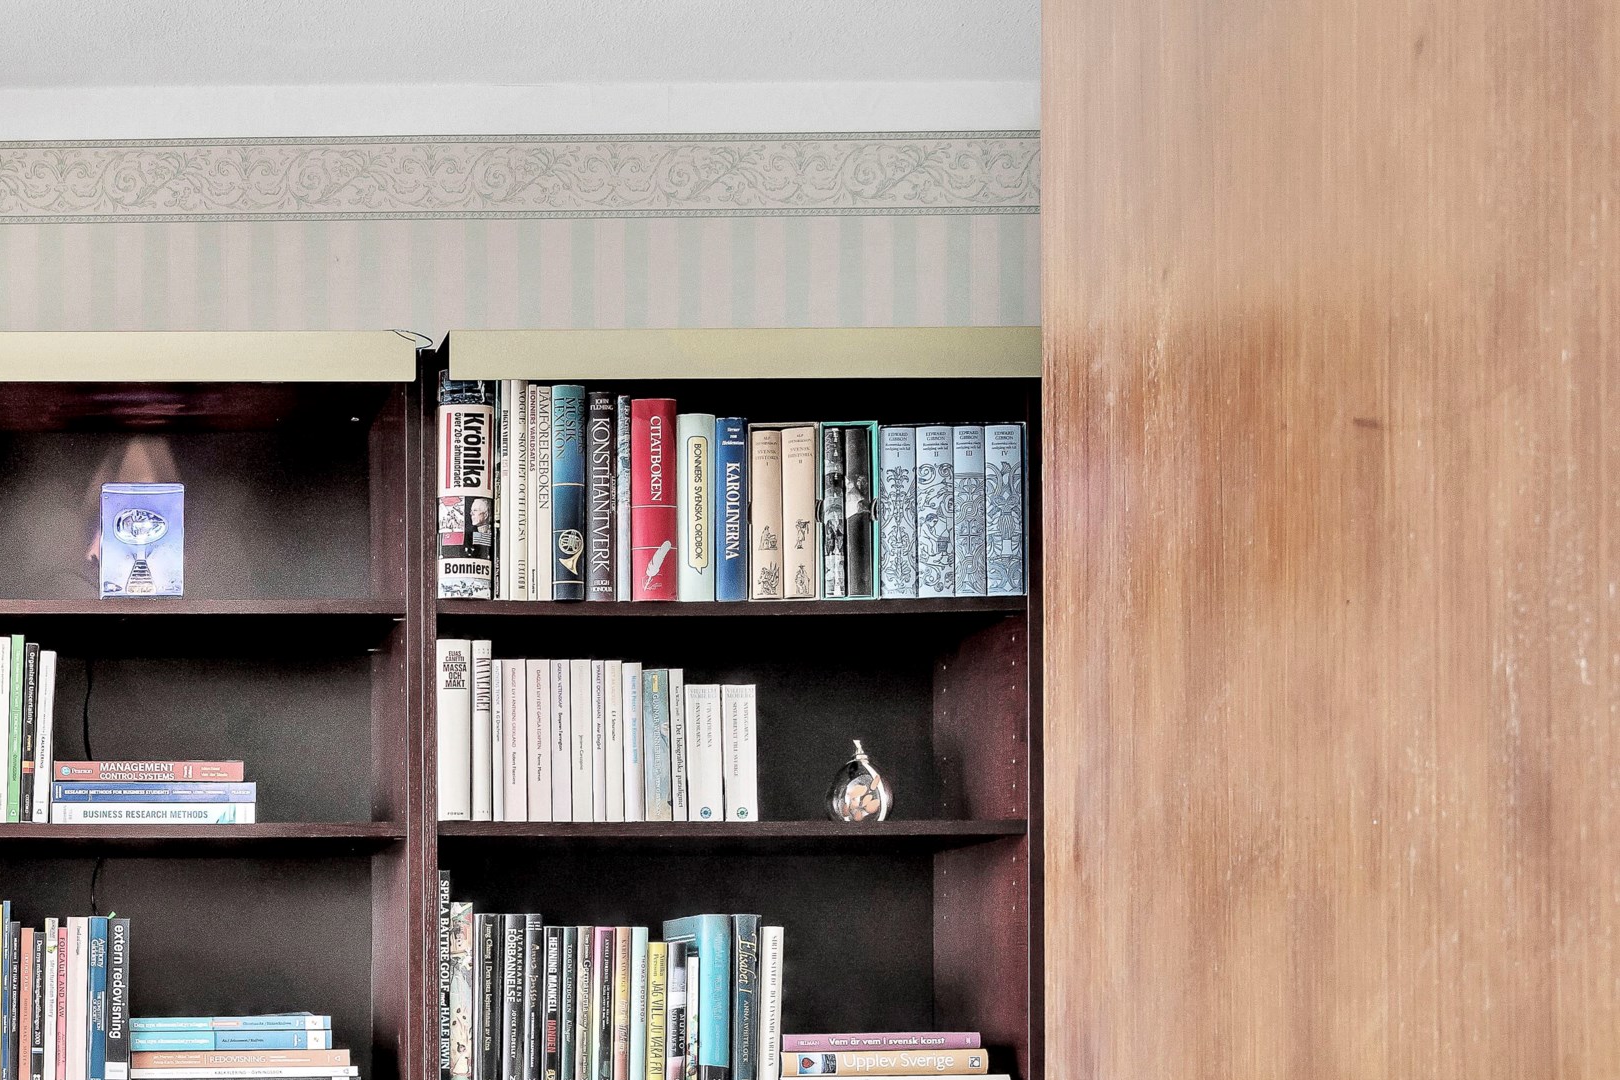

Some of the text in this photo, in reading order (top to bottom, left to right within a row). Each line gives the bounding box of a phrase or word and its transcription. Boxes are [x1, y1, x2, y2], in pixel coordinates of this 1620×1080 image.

[554, 397, 565, 460] LEXIKON
[566, 397, 576, 442] MUSIK
[463, 413, 485, 488] Krönika
[538, 390, 551, 509] JÄMFÖRELSEBOKEN
[651, 416, 662, 501] CITATBOKEN
[591, 417, 610, 572] KONSTHANTVERK
[694, 443, 703, 560] BONNIERS SVENSKA ORDBOK
[726, 462, 740, 560] KAROLINERNA
[444, 561, 490, 577] Bonniers
[443, 664, 467, 672] MASSA
[26, 687, 34, 725] Uncertainty
[100, 763, 174, 772] MANAGEMENT
[83, 810, 208, 819] BUSINESS RESEARCH METHODS
[440, 880, 449, 914] SPELA
[97, 938, 105, 968] Anthony
[440, 918, 450, 961] BÄTTRE
[108, 925, 125, 1039] extern redovisning
[440, 963, 450, 992] GOLF
[507, 928, 518, 1003] FÖRBANNELSE
[547, 937, 557, 1053] HENNING MANKELL HANDEN
[440, 1007, 450, 1036] HALE
[650, 981, 662, 1075] JAG VILL JU VARA FRI
[850, 1037, 861, 1045] är
[888, 1037, 919, 1045] svensk
[441, 1038, 450, 1069] IRWIN
[843, 1054, 954, 1071] Upplev Sverige
